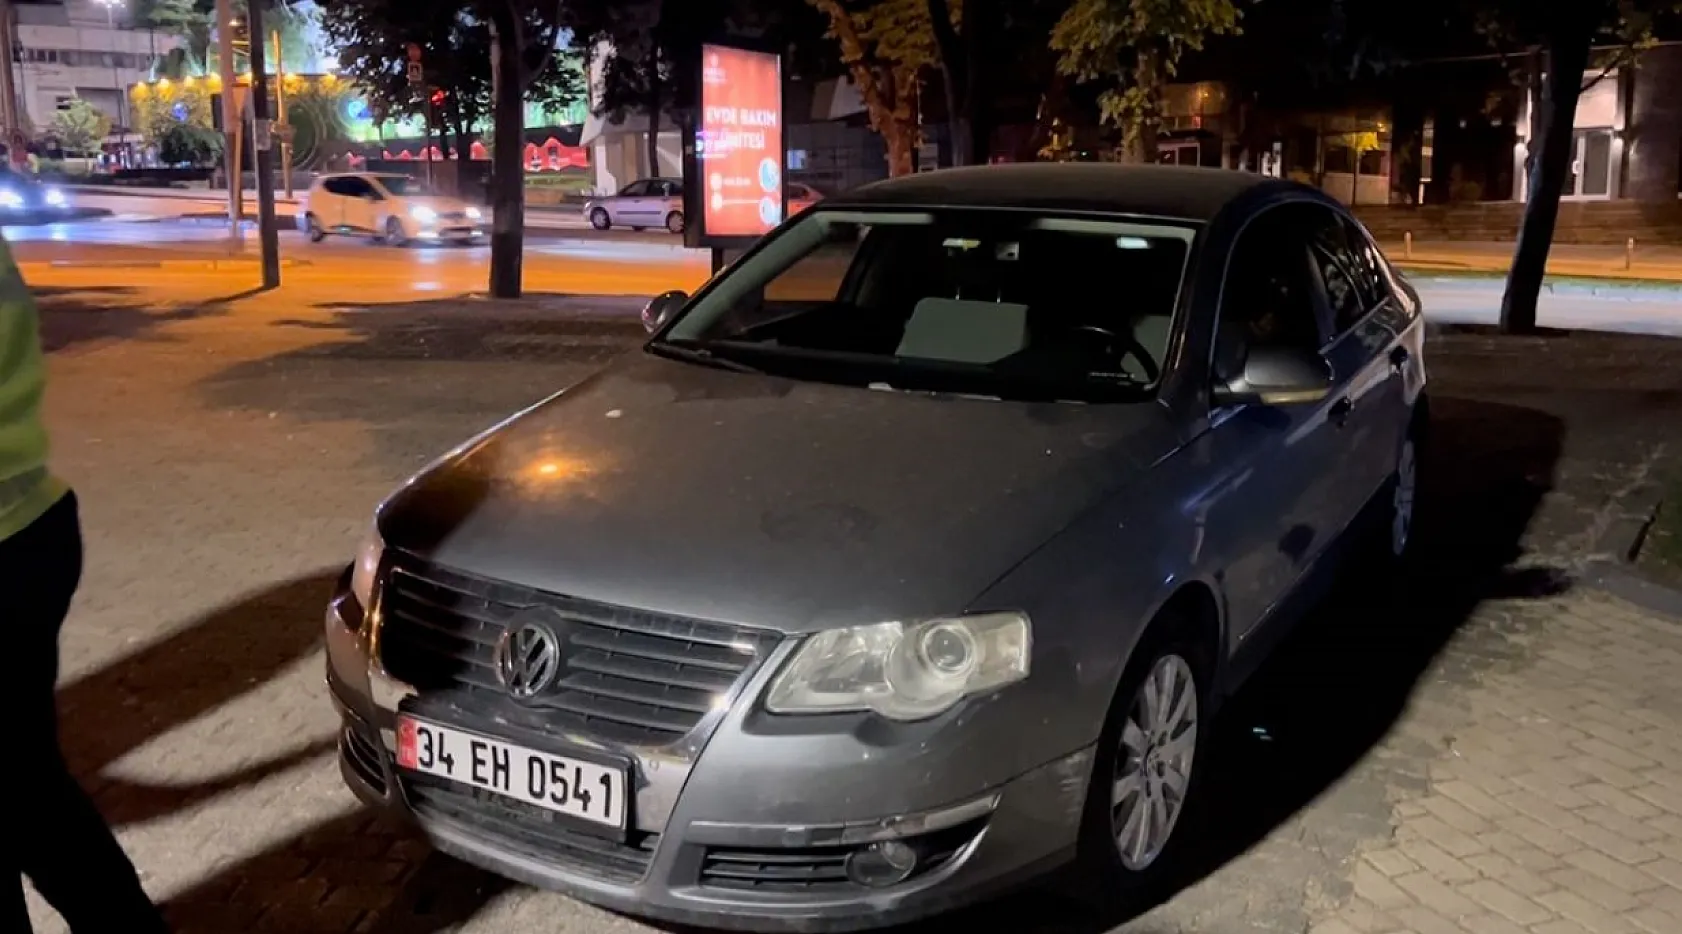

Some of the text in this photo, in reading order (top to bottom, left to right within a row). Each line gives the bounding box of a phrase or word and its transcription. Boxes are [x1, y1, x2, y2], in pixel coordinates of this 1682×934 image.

[416, 726, 612, 818] 34 EH 0541
